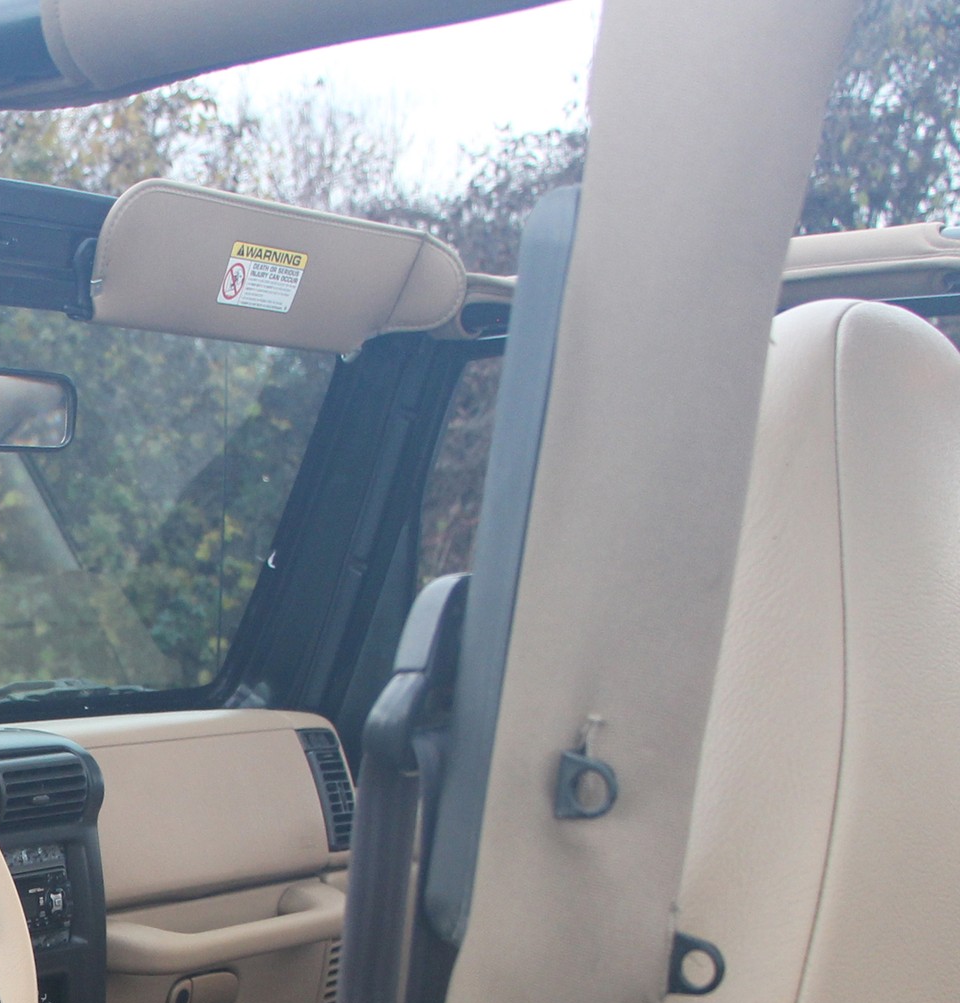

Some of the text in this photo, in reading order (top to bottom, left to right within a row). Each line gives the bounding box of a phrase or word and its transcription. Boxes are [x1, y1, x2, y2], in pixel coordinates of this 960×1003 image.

[246, 246, 302, 266] WARNING
[250, 270, 299, 284] INJURY CAN OCCUR
[253, 263, 300, 277] DEATH OR SERIOUS
